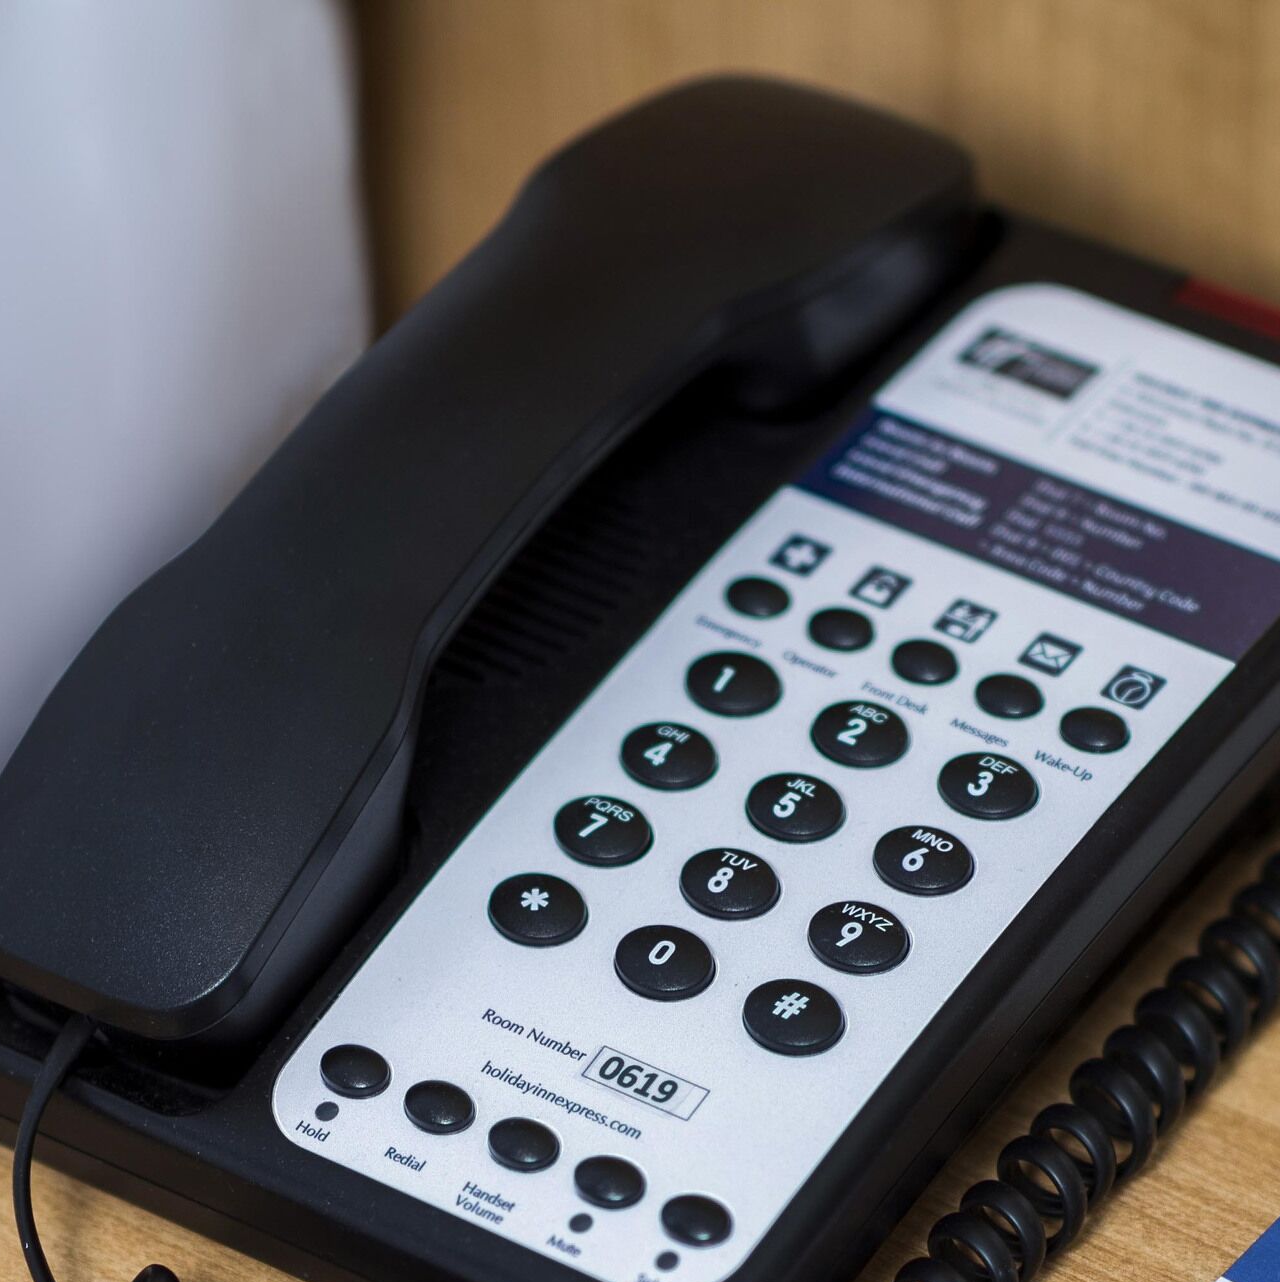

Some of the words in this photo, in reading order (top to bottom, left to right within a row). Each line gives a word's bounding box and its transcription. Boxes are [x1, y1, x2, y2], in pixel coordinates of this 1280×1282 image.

[695, 615, 762, 650] Emergency
[783, 652, 838, 679] Operator
[713, 667, 735, 692] 1
[860, 681, 895, 701] Front
[895, 695, 928, 715] Desk
[850, 704, 888, 723] ABC
[657, 721, 690, 743] GHI
[837, 718, 867, 746] 2
[950, 718, 1009, 747] Messages
[644, 742, 673, 766] 4
[978, 756, 1018, 774] DEF
[1034, 750, 1093, 782] Wake-Up
[786, 778, 816, 798] JKL
[967, 771, 994, 797] 3
[584, 794, 634, 822] PQRS
[773, 791, 802, 818] 5
[578, 812, 609, 838] 7
[911, 829, 954, 852] MNO
[721, 851, 758, 871] TUV
[901, 847, 930, 872] 6
[707, 867, 734, 893] 8
[841, 903, 894, 932] WXYZ
[835, 921, 863, 947] 9
[648, 940, 676, 965] 0
[481, 1008, 525, 1036] Room
[526, 1027, 588, 1061] Number
[598, 1056, 679, 1104] 0619
[480, 1060, 642, 1140] holidayinnexpress.com
[295, 1120, 331, 1142] Hold
[384, 1146, 427, 1172] Redial
[455, 1194, 504, 1225] Volume
[462, 1181, 516, 1213] Handset
[546, 1235, 582, 1257] Mute
